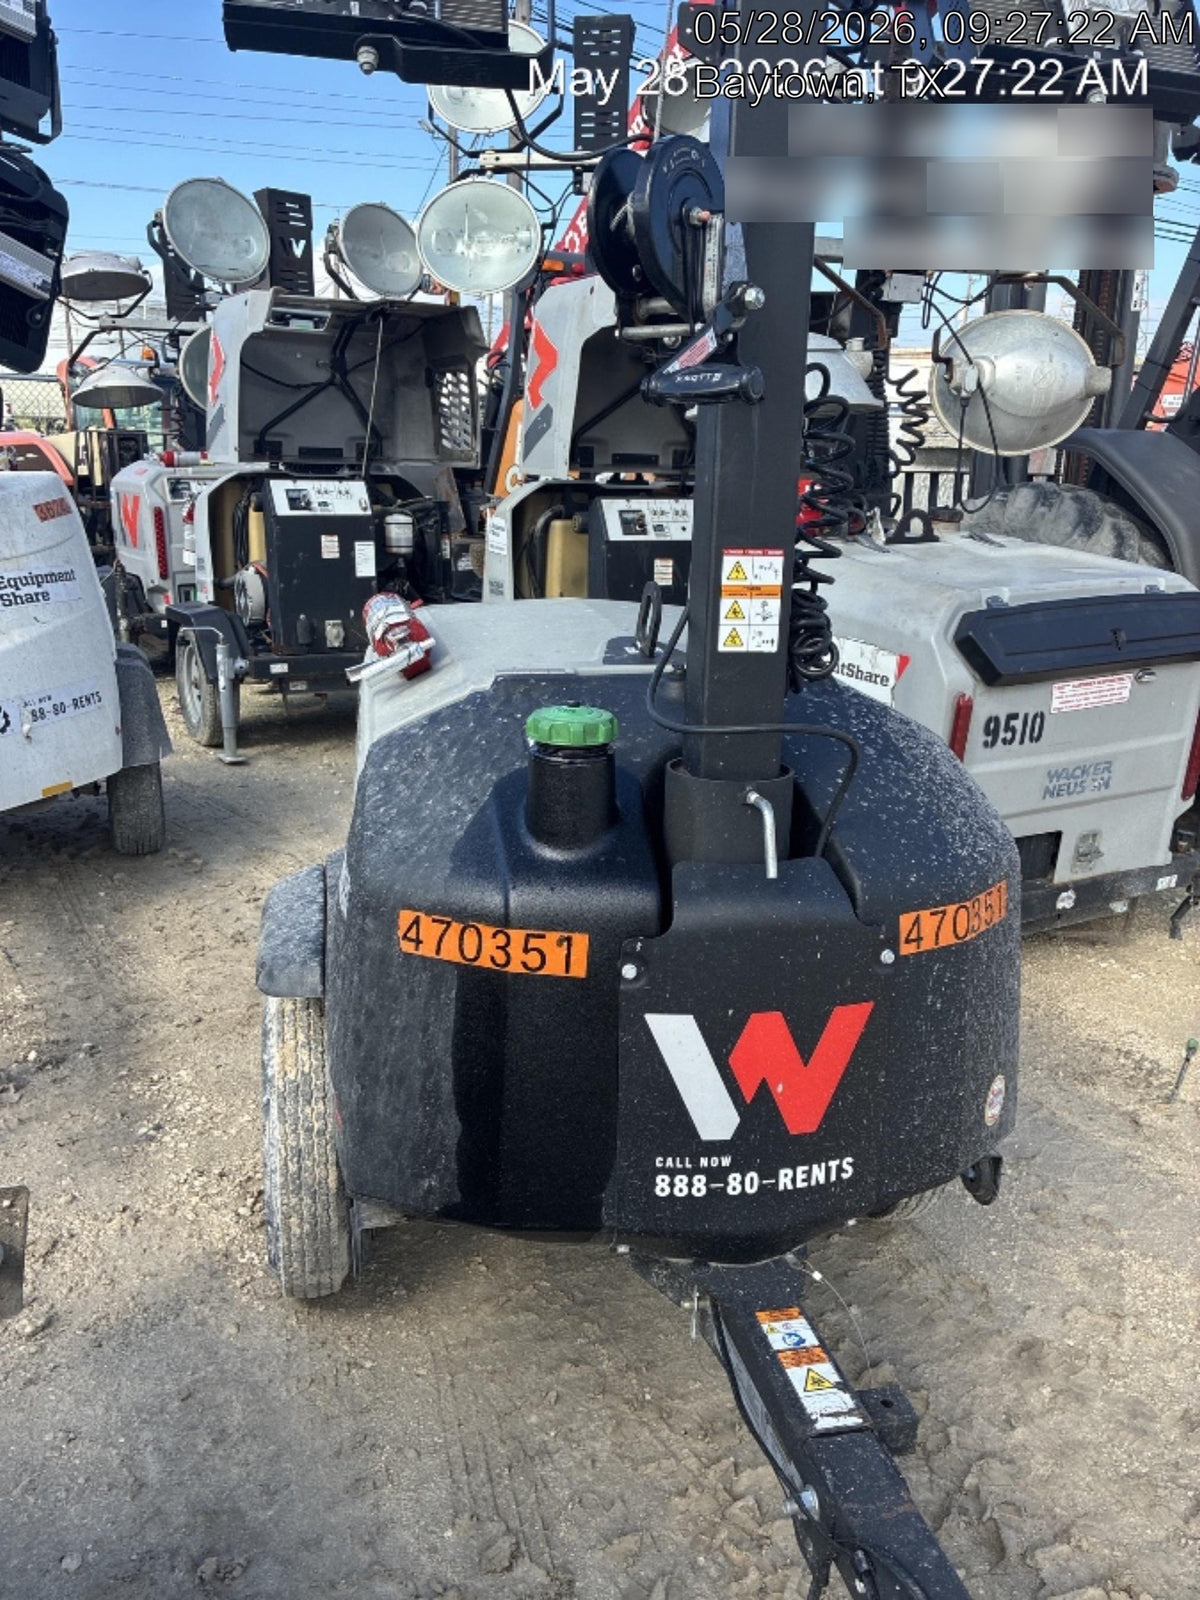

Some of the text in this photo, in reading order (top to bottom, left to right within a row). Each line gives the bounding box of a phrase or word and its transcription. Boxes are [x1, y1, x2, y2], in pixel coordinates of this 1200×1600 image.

[0, 568, 77, 591] Equipment
[1, 591, 51, 607] Share
[31, 691, 102, 722] 88-80-RENTS
[982, 710, 1046, 749] 9510
[1047, 760, 1112, 783] WACKER
[904, 885, 1003, 950] 470351
[401, 915, 573, 974] 470351
[655, 1155, 733, 1168] CALL NOW
[654, 1157, 855, 1198] 888-80-RENTS
